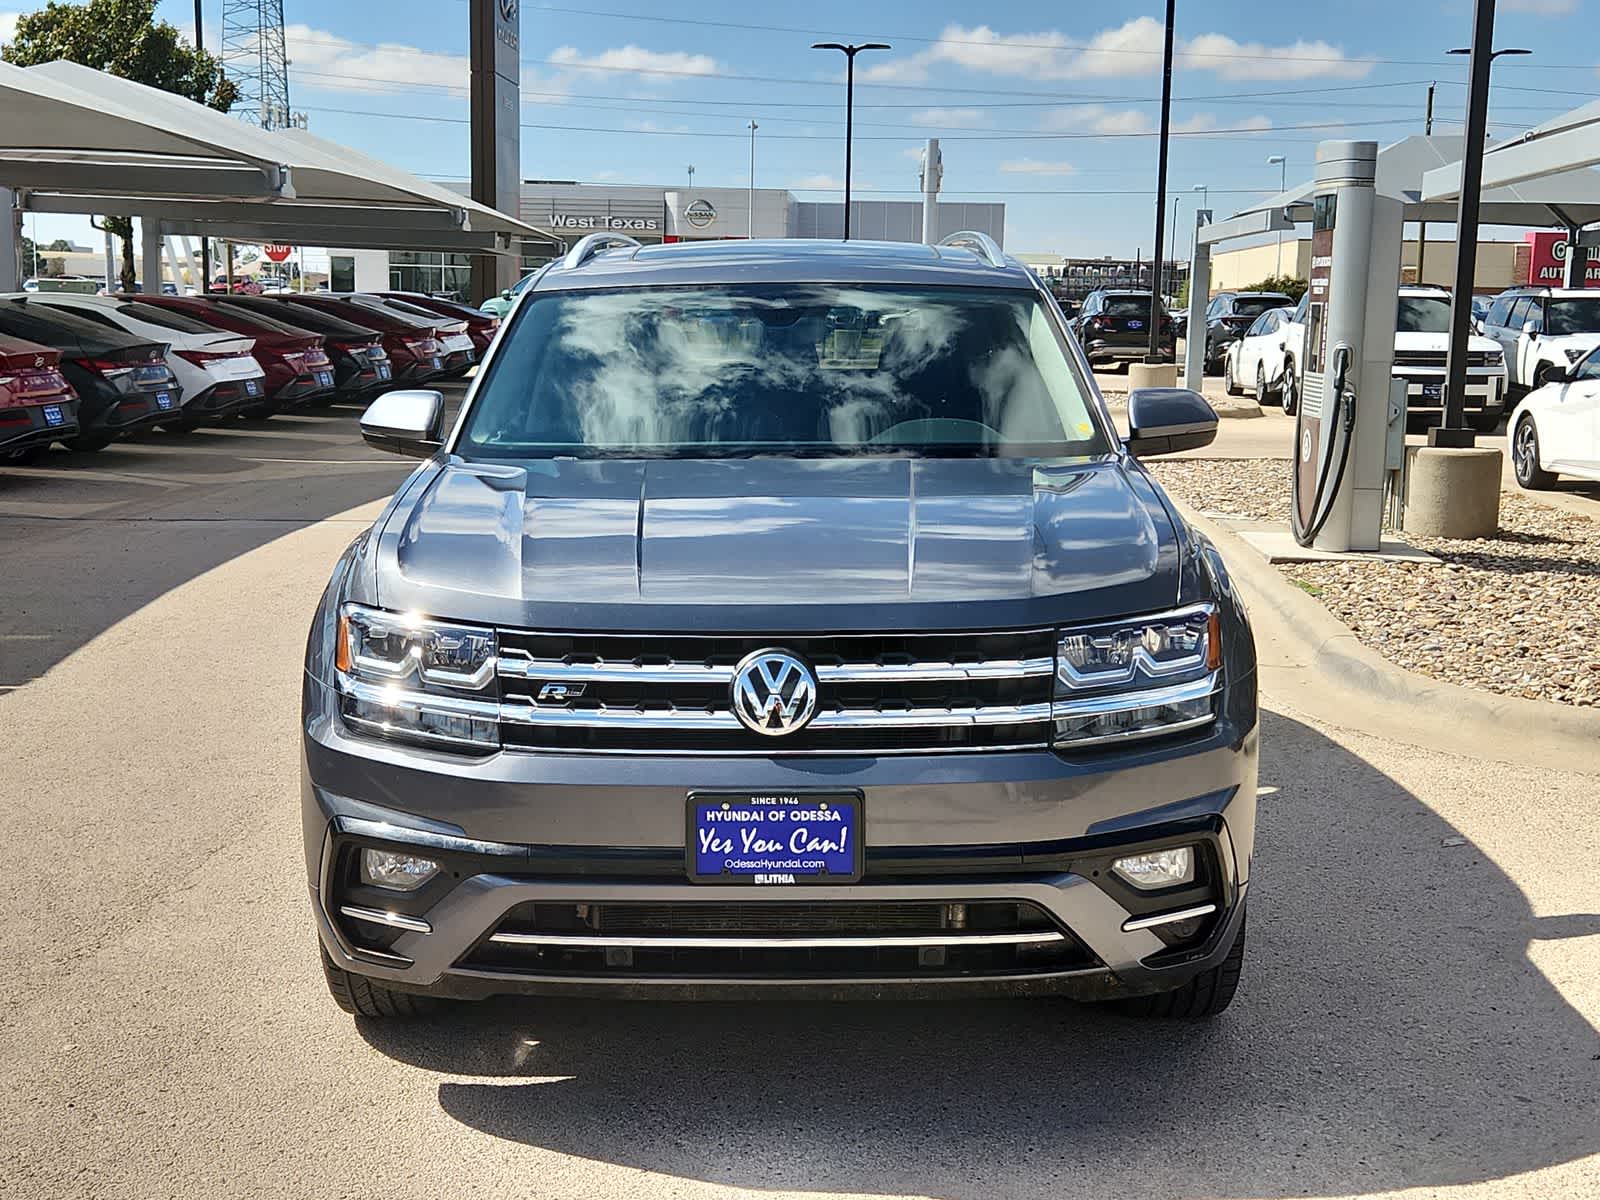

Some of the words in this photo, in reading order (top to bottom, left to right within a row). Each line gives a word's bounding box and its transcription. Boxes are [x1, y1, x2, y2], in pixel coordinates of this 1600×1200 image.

[549, 214, 594, 229] West
[601, 215, 657, 230] Texas
[751, 797, 777, 805] SINCE
[779, 797, 799, 805] 1946
[706, 810, 764, 822] HYUNDAI
[768, 810, 786, 822] OF
[790, 810, 841, 822] ODESSA
[699, 827, 734, 854] Yes
[740, 827, 783, 854] You
[789, 826, 848, 854] Can!
[724, 859, 825, 869] OdessaHyundai.com
[764, 874, 796, 884] LITHIA
